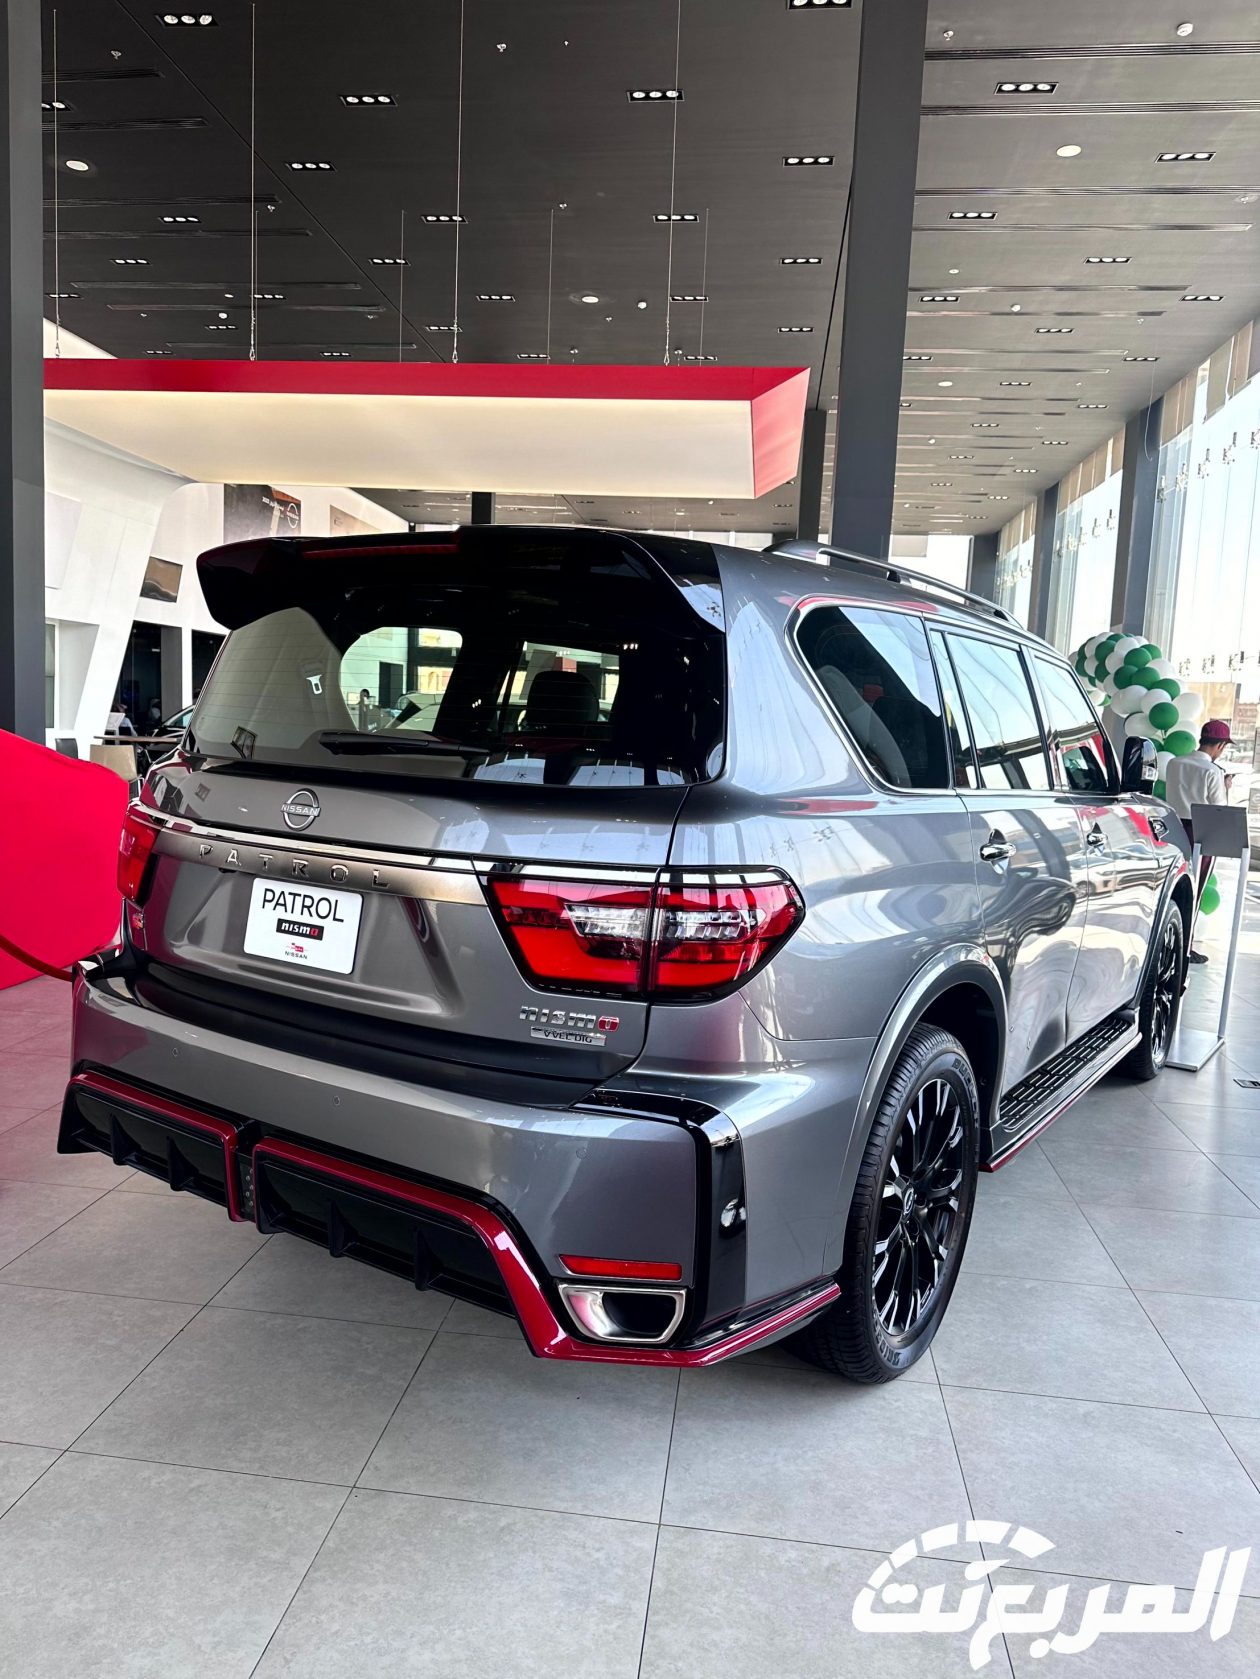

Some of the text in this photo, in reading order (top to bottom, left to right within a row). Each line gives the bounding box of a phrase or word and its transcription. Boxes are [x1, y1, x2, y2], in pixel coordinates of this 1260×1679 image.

[281, 804, 319, 816] NISSAN
[199, 844, 390, 888] PATROL
[262, 887, 344, 923] PATROL
[284, 951, 308, 959] NISSAN
[543, 1030, 592, 1044] VVEL DIG
